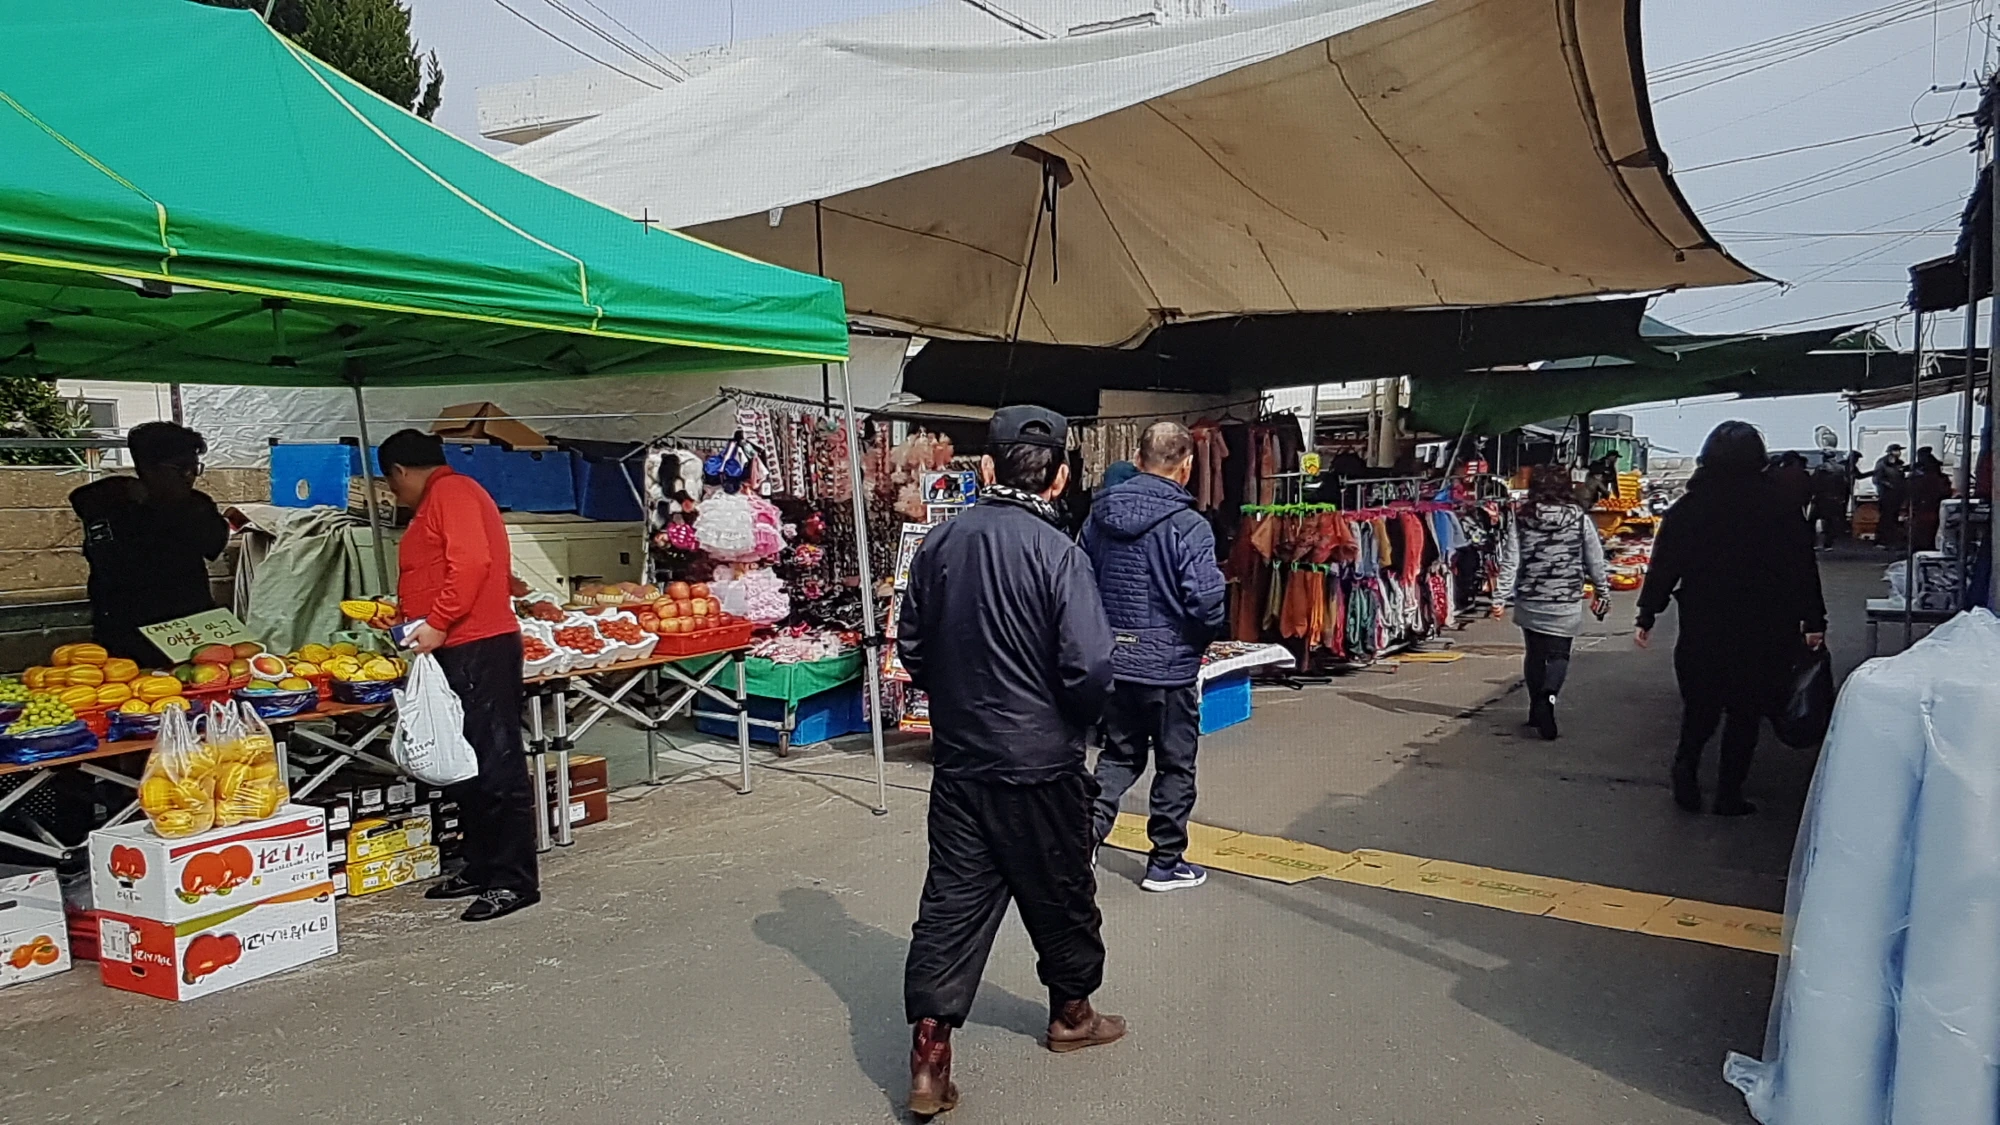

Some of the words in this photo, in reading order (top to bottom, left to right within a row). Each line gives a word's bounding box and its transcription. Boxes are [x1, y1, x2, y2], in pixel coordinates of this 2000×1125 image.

[167, 628, 204, 646] 애플
[205, 620, 240, 638] 망고
[257, 843, 305, 869] 사과
